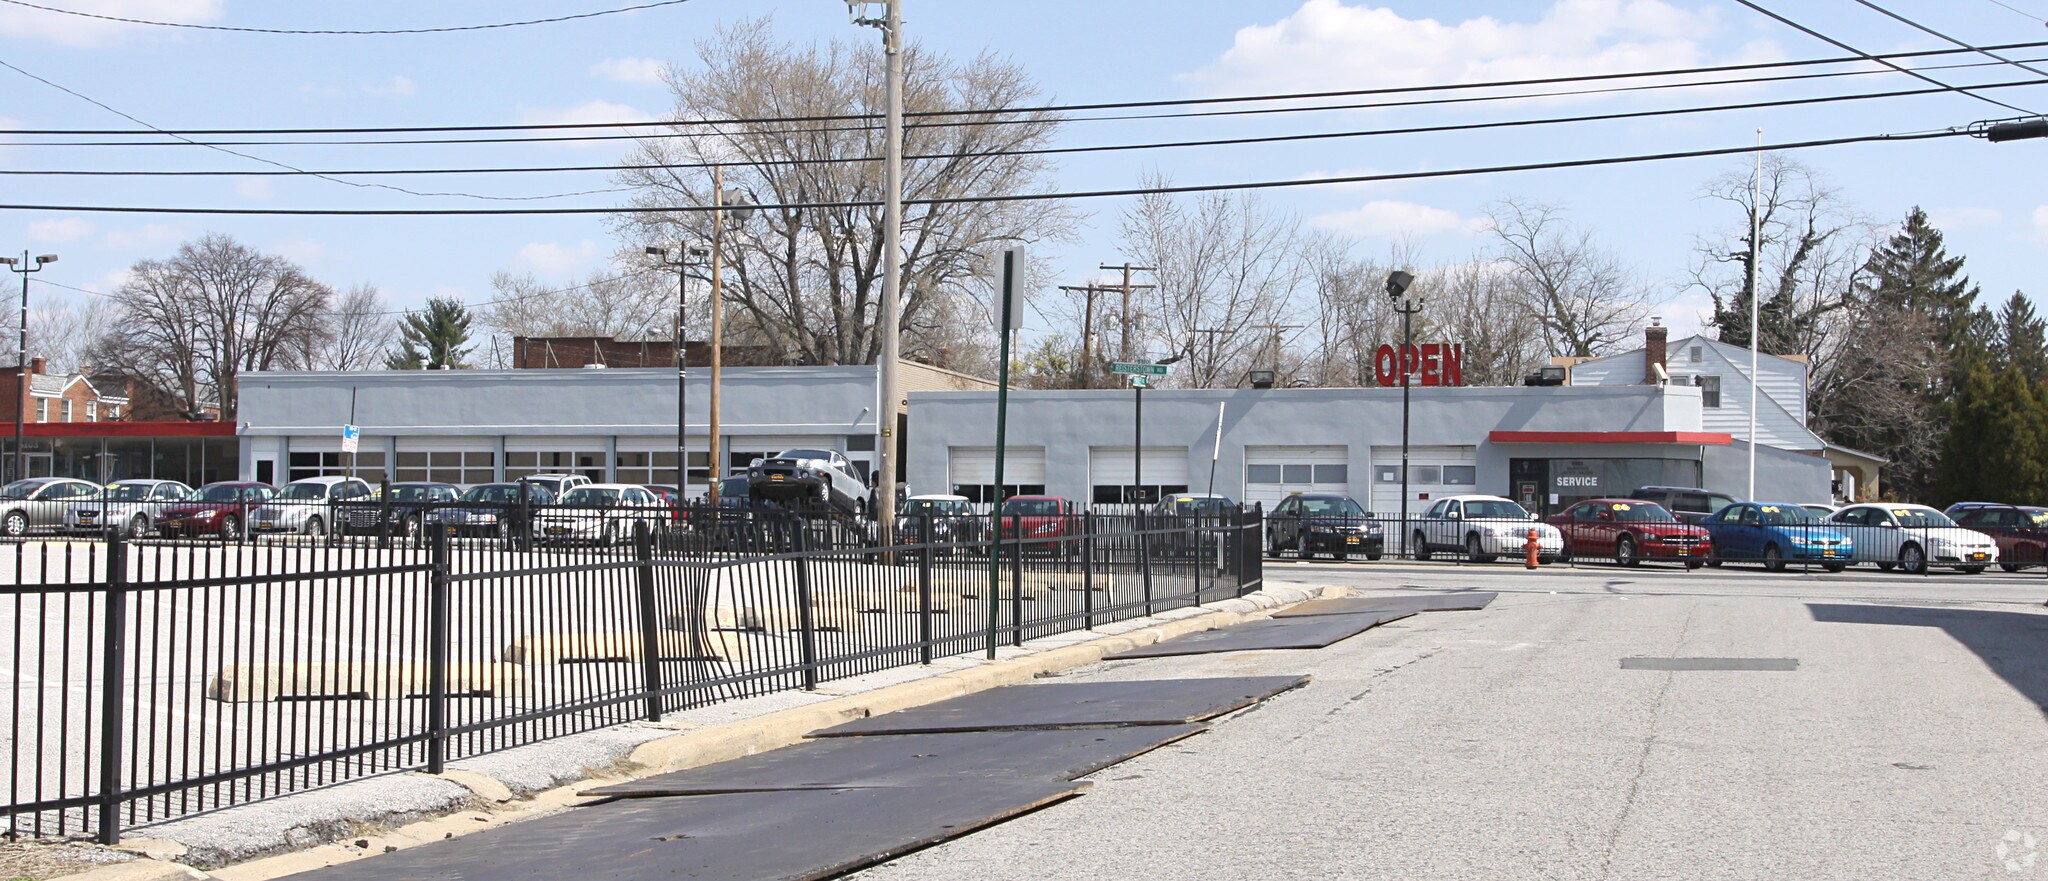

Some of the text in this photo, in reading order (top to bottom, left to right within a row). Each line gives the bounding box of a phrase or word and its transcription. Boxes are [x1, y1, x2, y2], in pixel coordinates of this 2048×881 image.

[1114, 364, 1155, 374] REISTERSTOWN
[1375, 343, 1462, 387] OPEN
[1556, 476, 1598, 487] SERVICE
